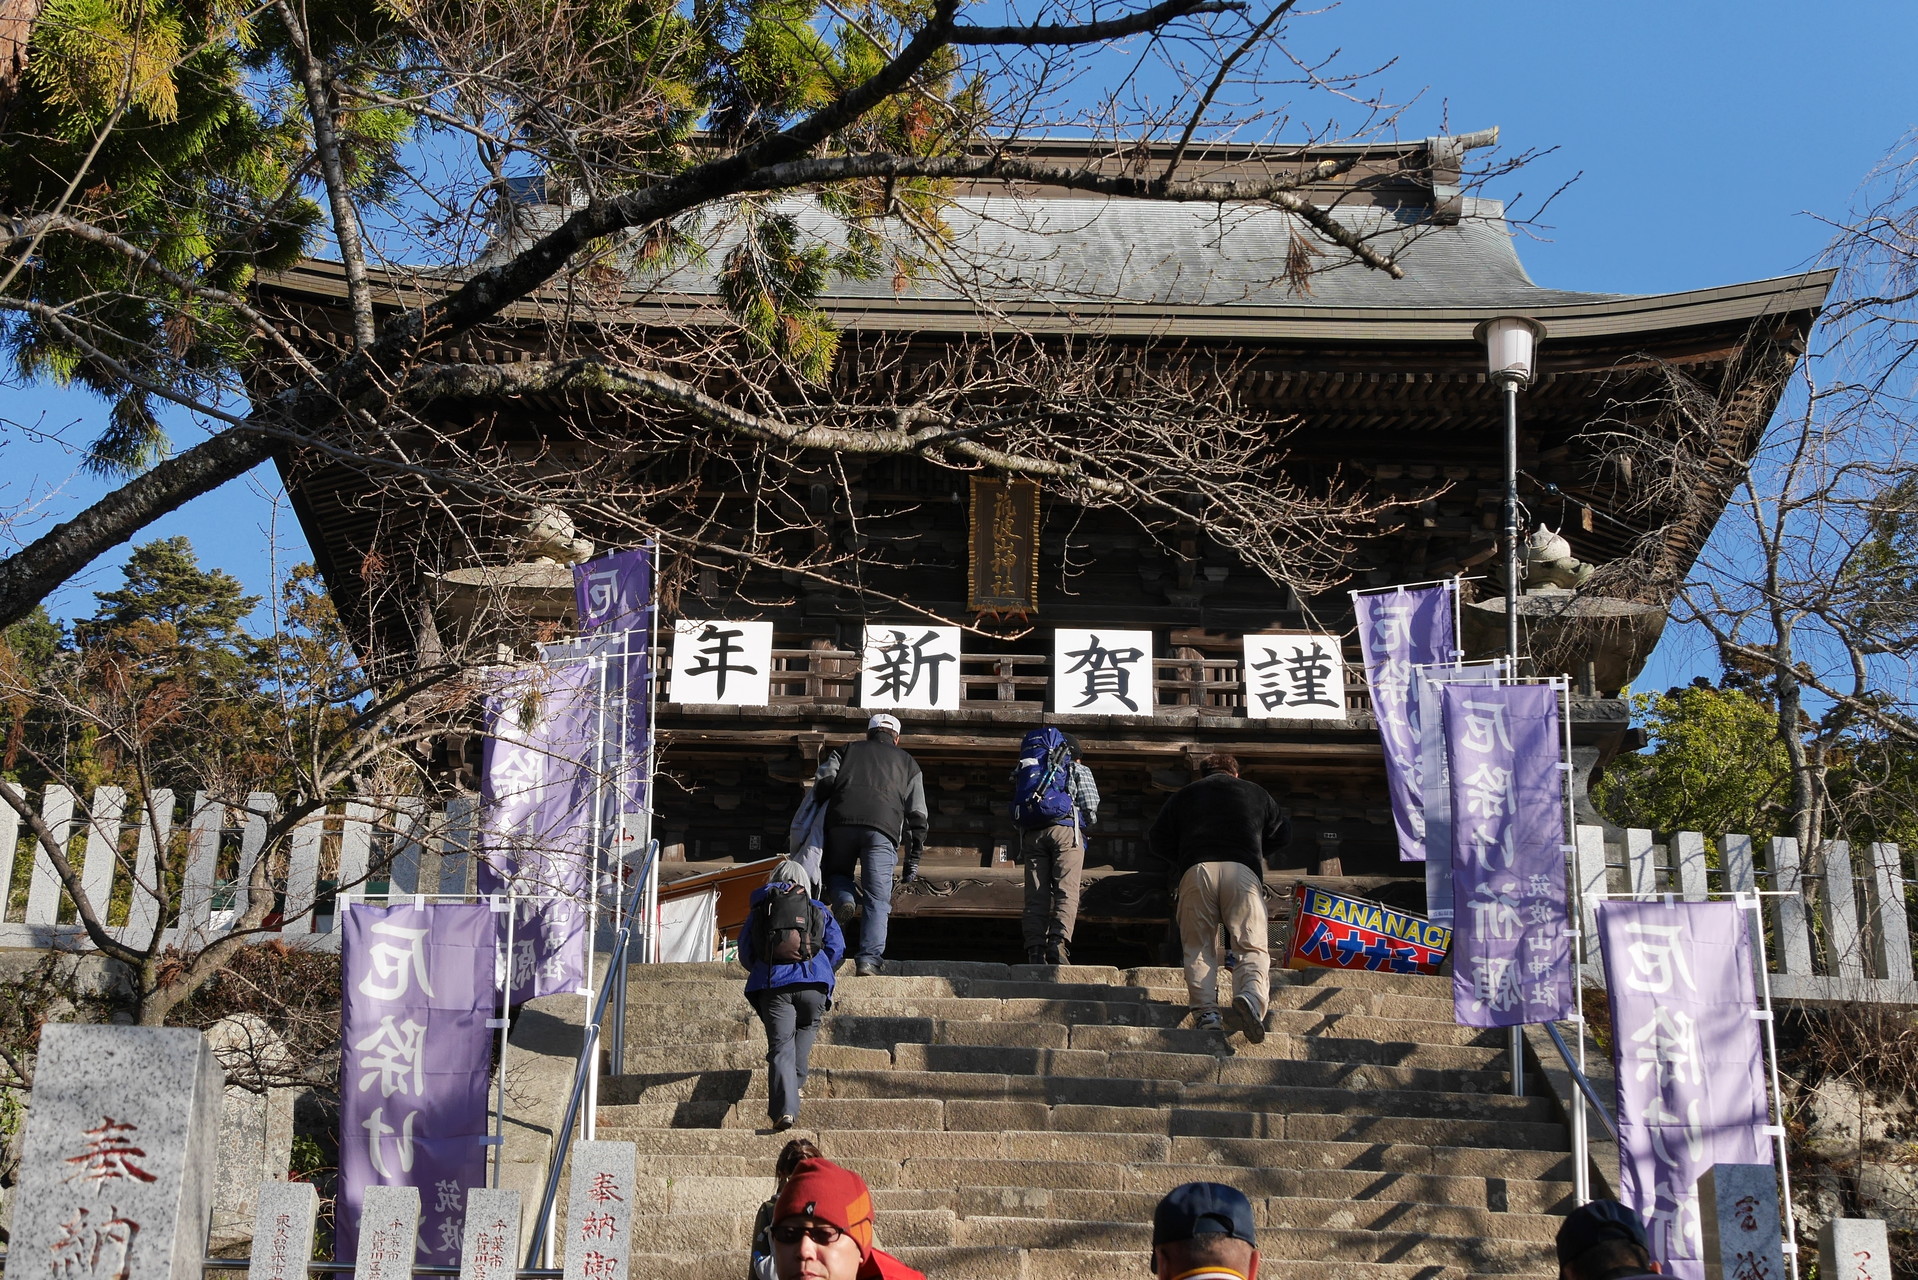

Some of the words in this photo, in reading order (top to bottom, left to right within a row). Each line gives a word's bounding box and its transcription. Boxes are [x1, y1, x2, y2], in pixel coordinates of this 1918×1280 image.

[685, 622, 757, 701] 年
[869, 628, 957, 706] 新
[1063, 635, 1145, 713] 賀
[1250, 642, 1340, 714] 謹
[1301, 920, 1445, 976] バナナチ
[265, 1213, 291, 1280] 東久留米市
[473, 1232, 490, 1280] 花見川区
